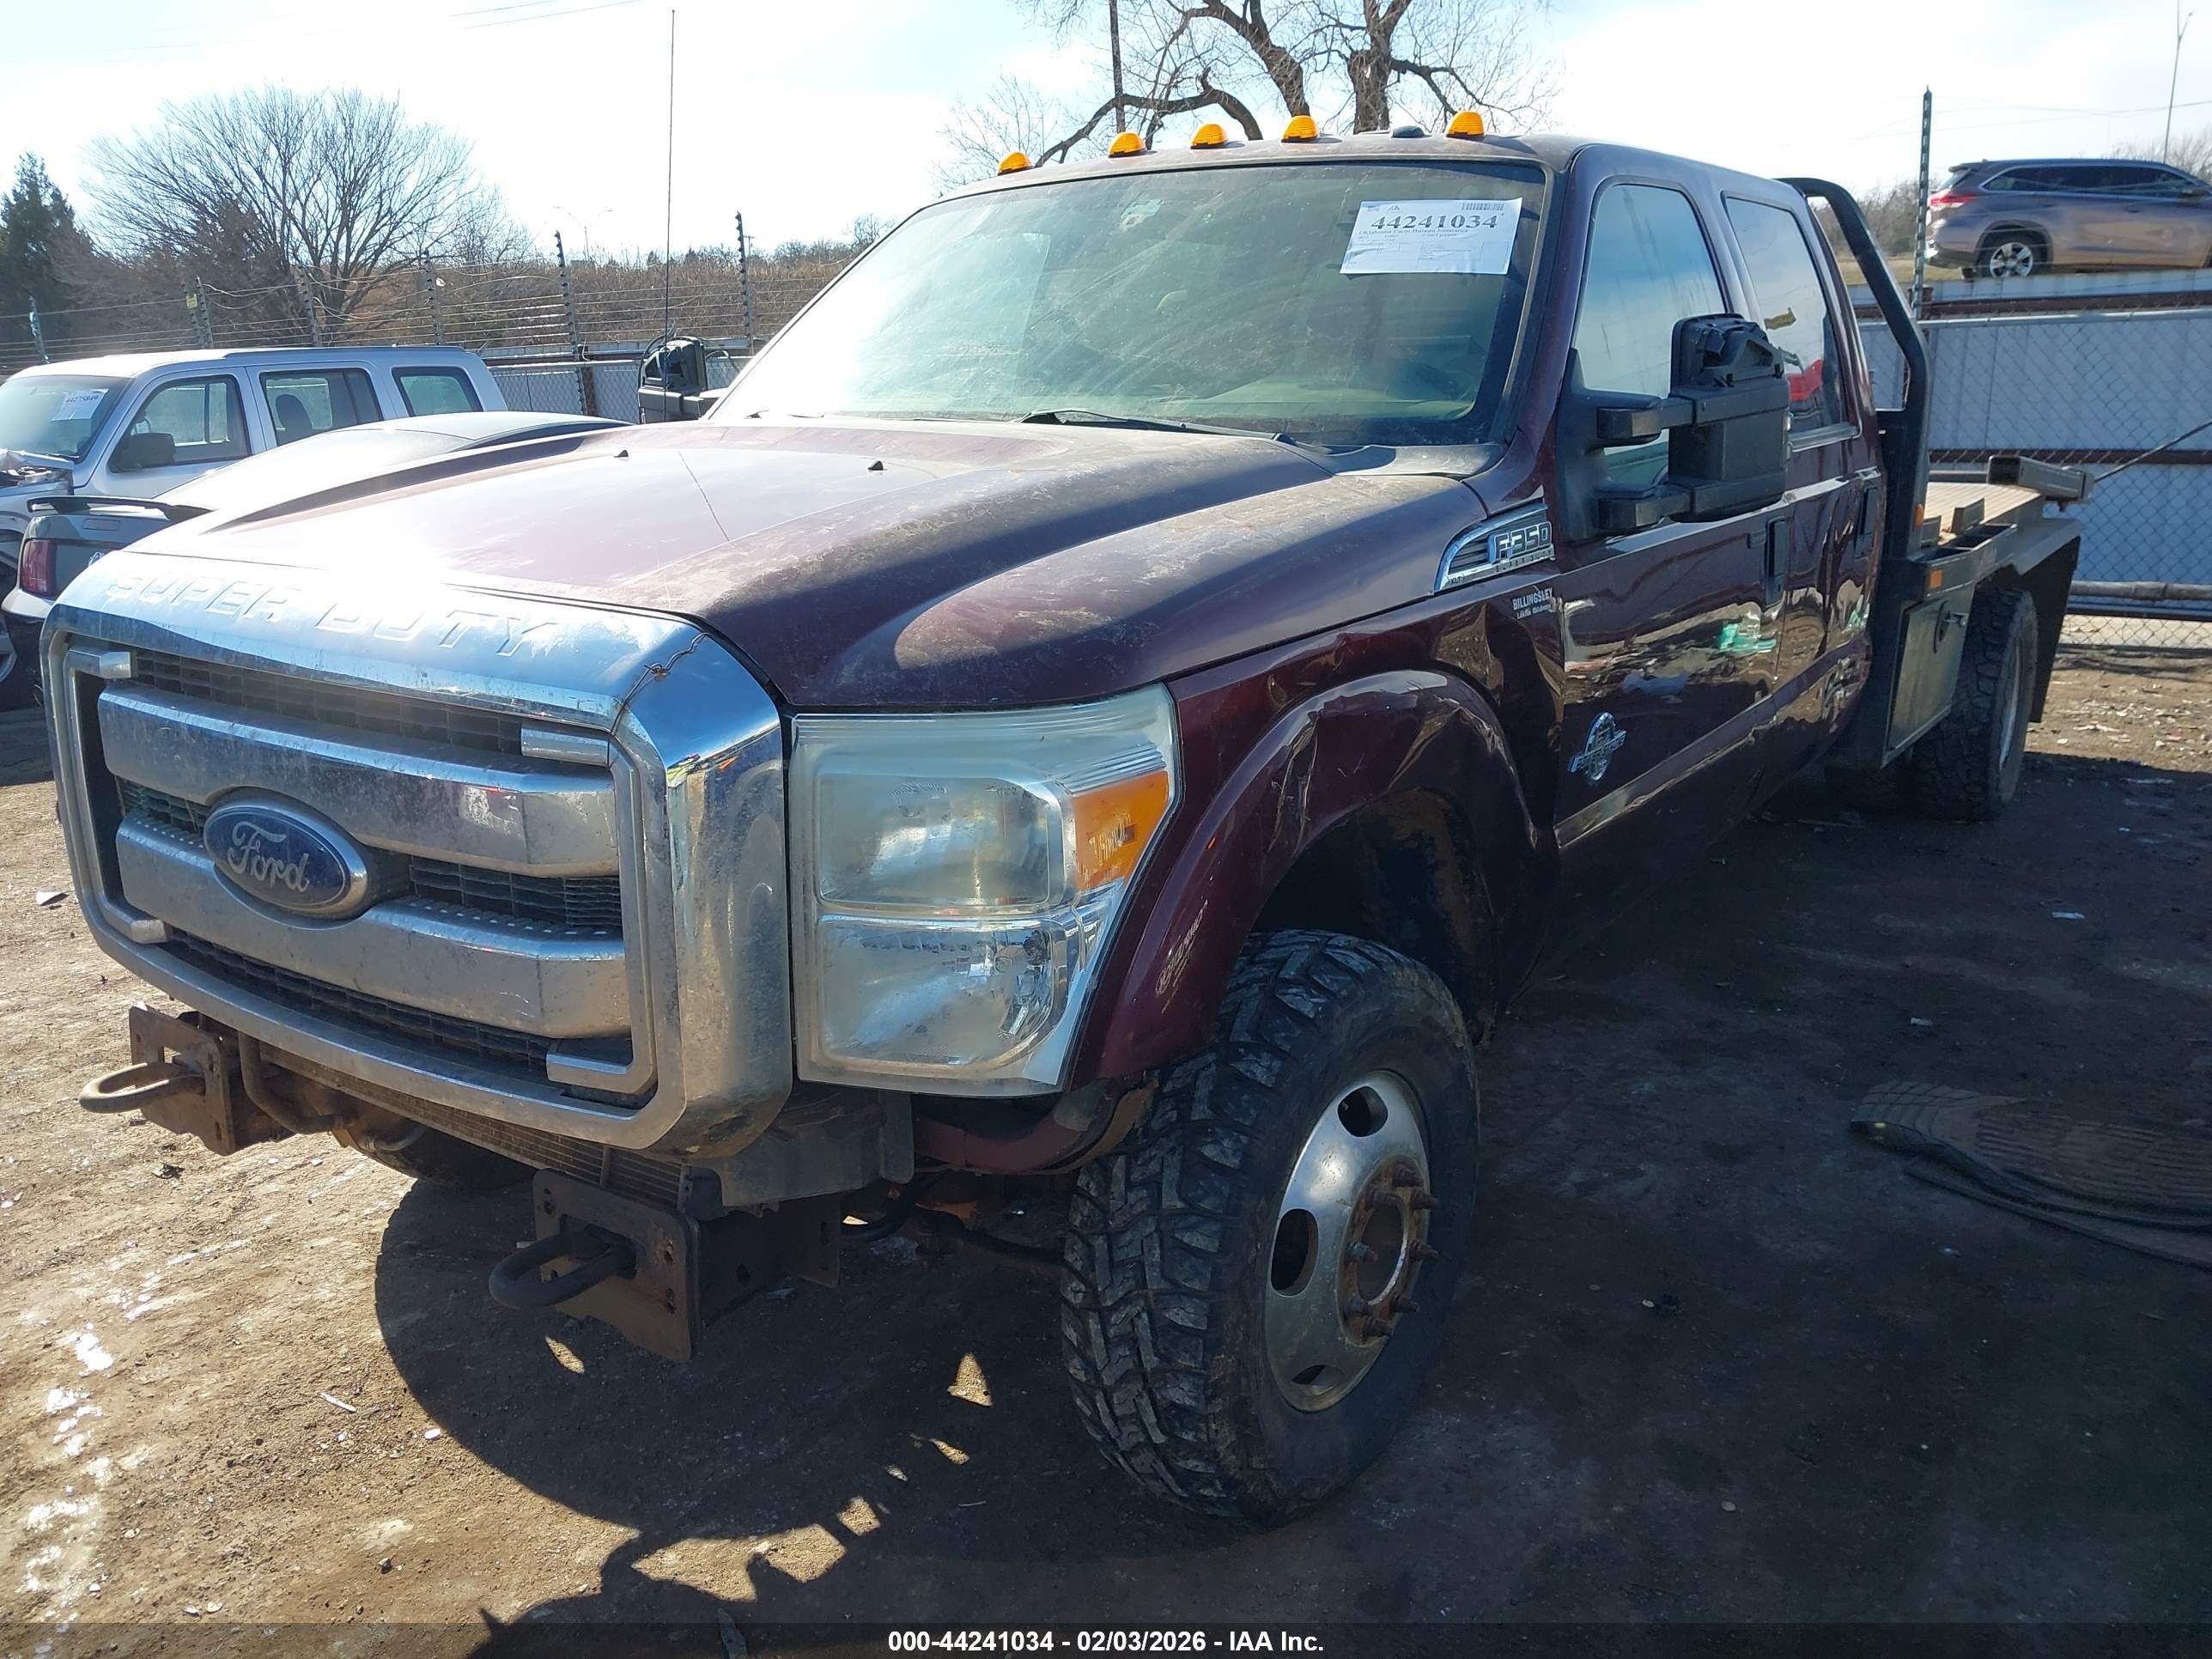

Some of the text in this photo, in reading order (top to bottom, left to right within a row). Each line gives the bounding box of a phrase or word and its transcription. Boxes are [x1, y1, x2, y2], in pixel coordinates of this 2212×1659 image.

[1370, 215, 1498, 229] 44241034
[106, 575, 560, 658] SUPER DUTY
[1512, 588, 1553, 610] BILLINGSLEY
[228, 821, 310, 893] Ford
